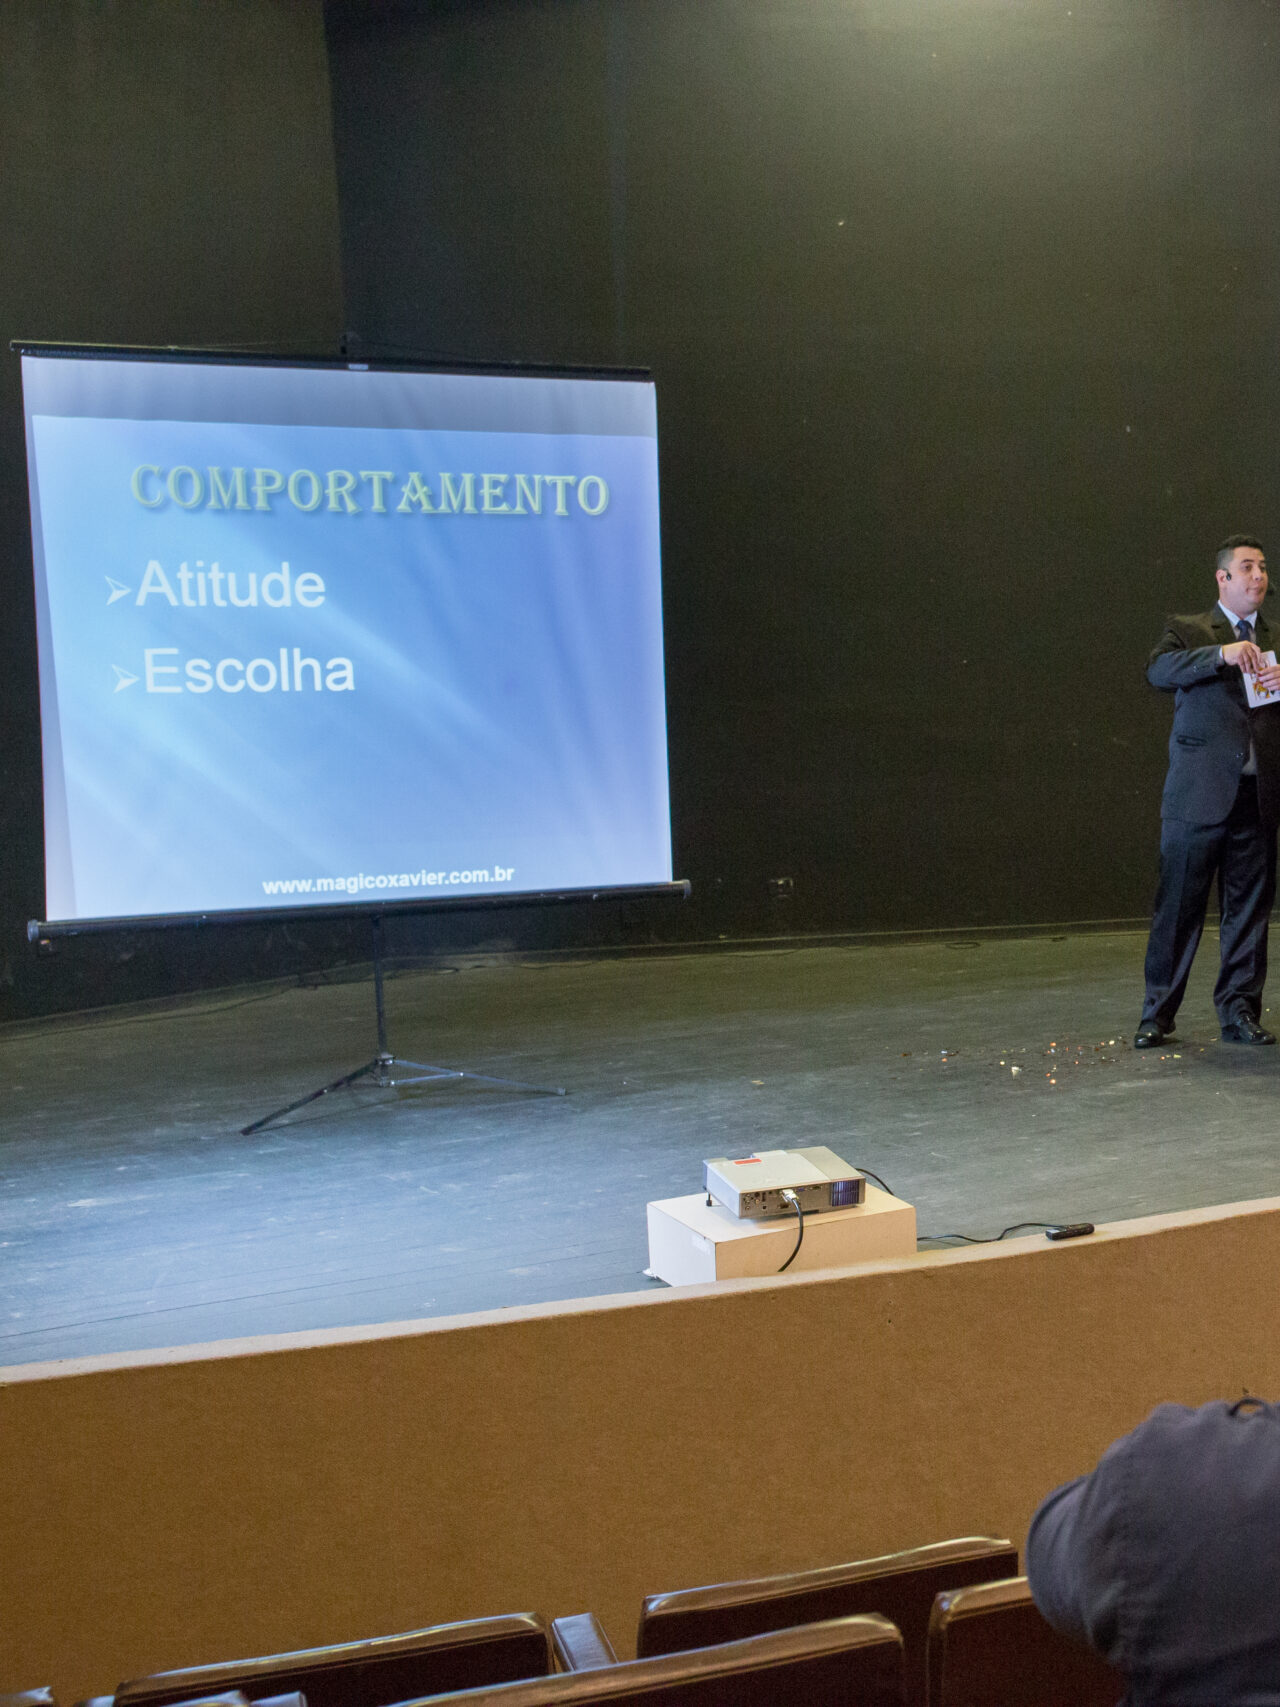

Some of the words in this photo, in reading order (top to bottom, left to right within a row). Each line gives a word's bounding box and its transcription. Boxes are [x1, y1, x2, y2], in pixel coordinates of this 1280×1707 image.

[131, 464, 610, 516] COMPORTAMENTO
[135, 560, 326, 607] Atitude
[143, 648, 355, 694] Escolha
[262, 866, 515, 894] www.magicoxavier.com.br
